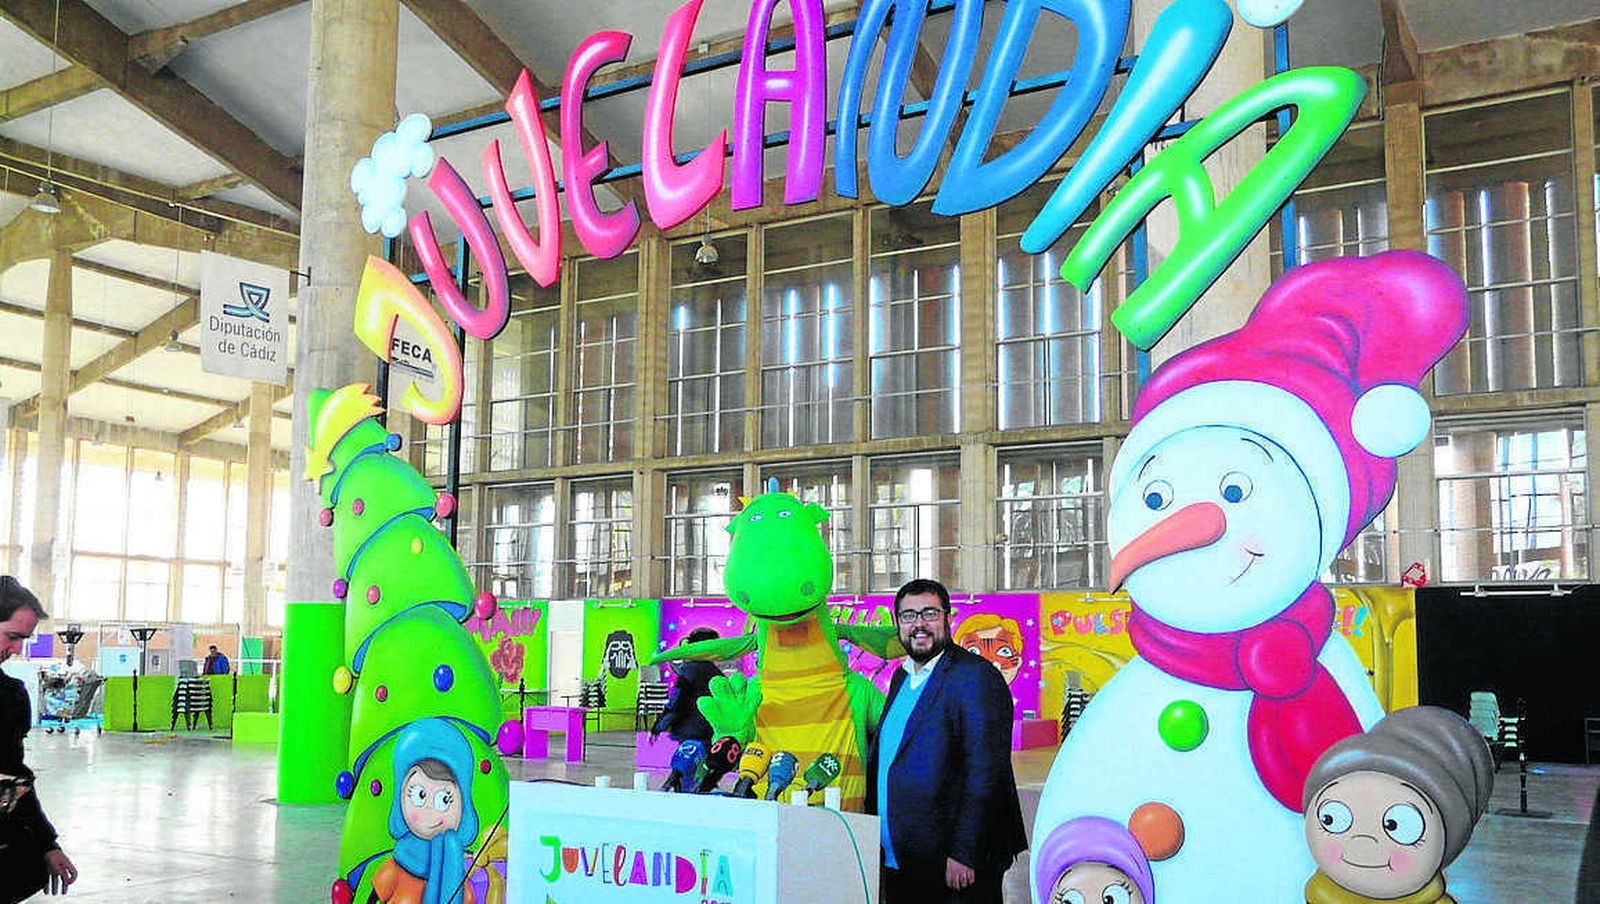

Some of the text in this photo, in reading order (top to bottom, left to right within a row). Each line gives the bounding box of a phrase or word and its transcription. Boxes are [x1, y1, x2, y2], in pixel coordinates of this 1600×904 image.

[209, 315, 281, 343] Diputación
[218, 339, 277, 363] de Cádiz
